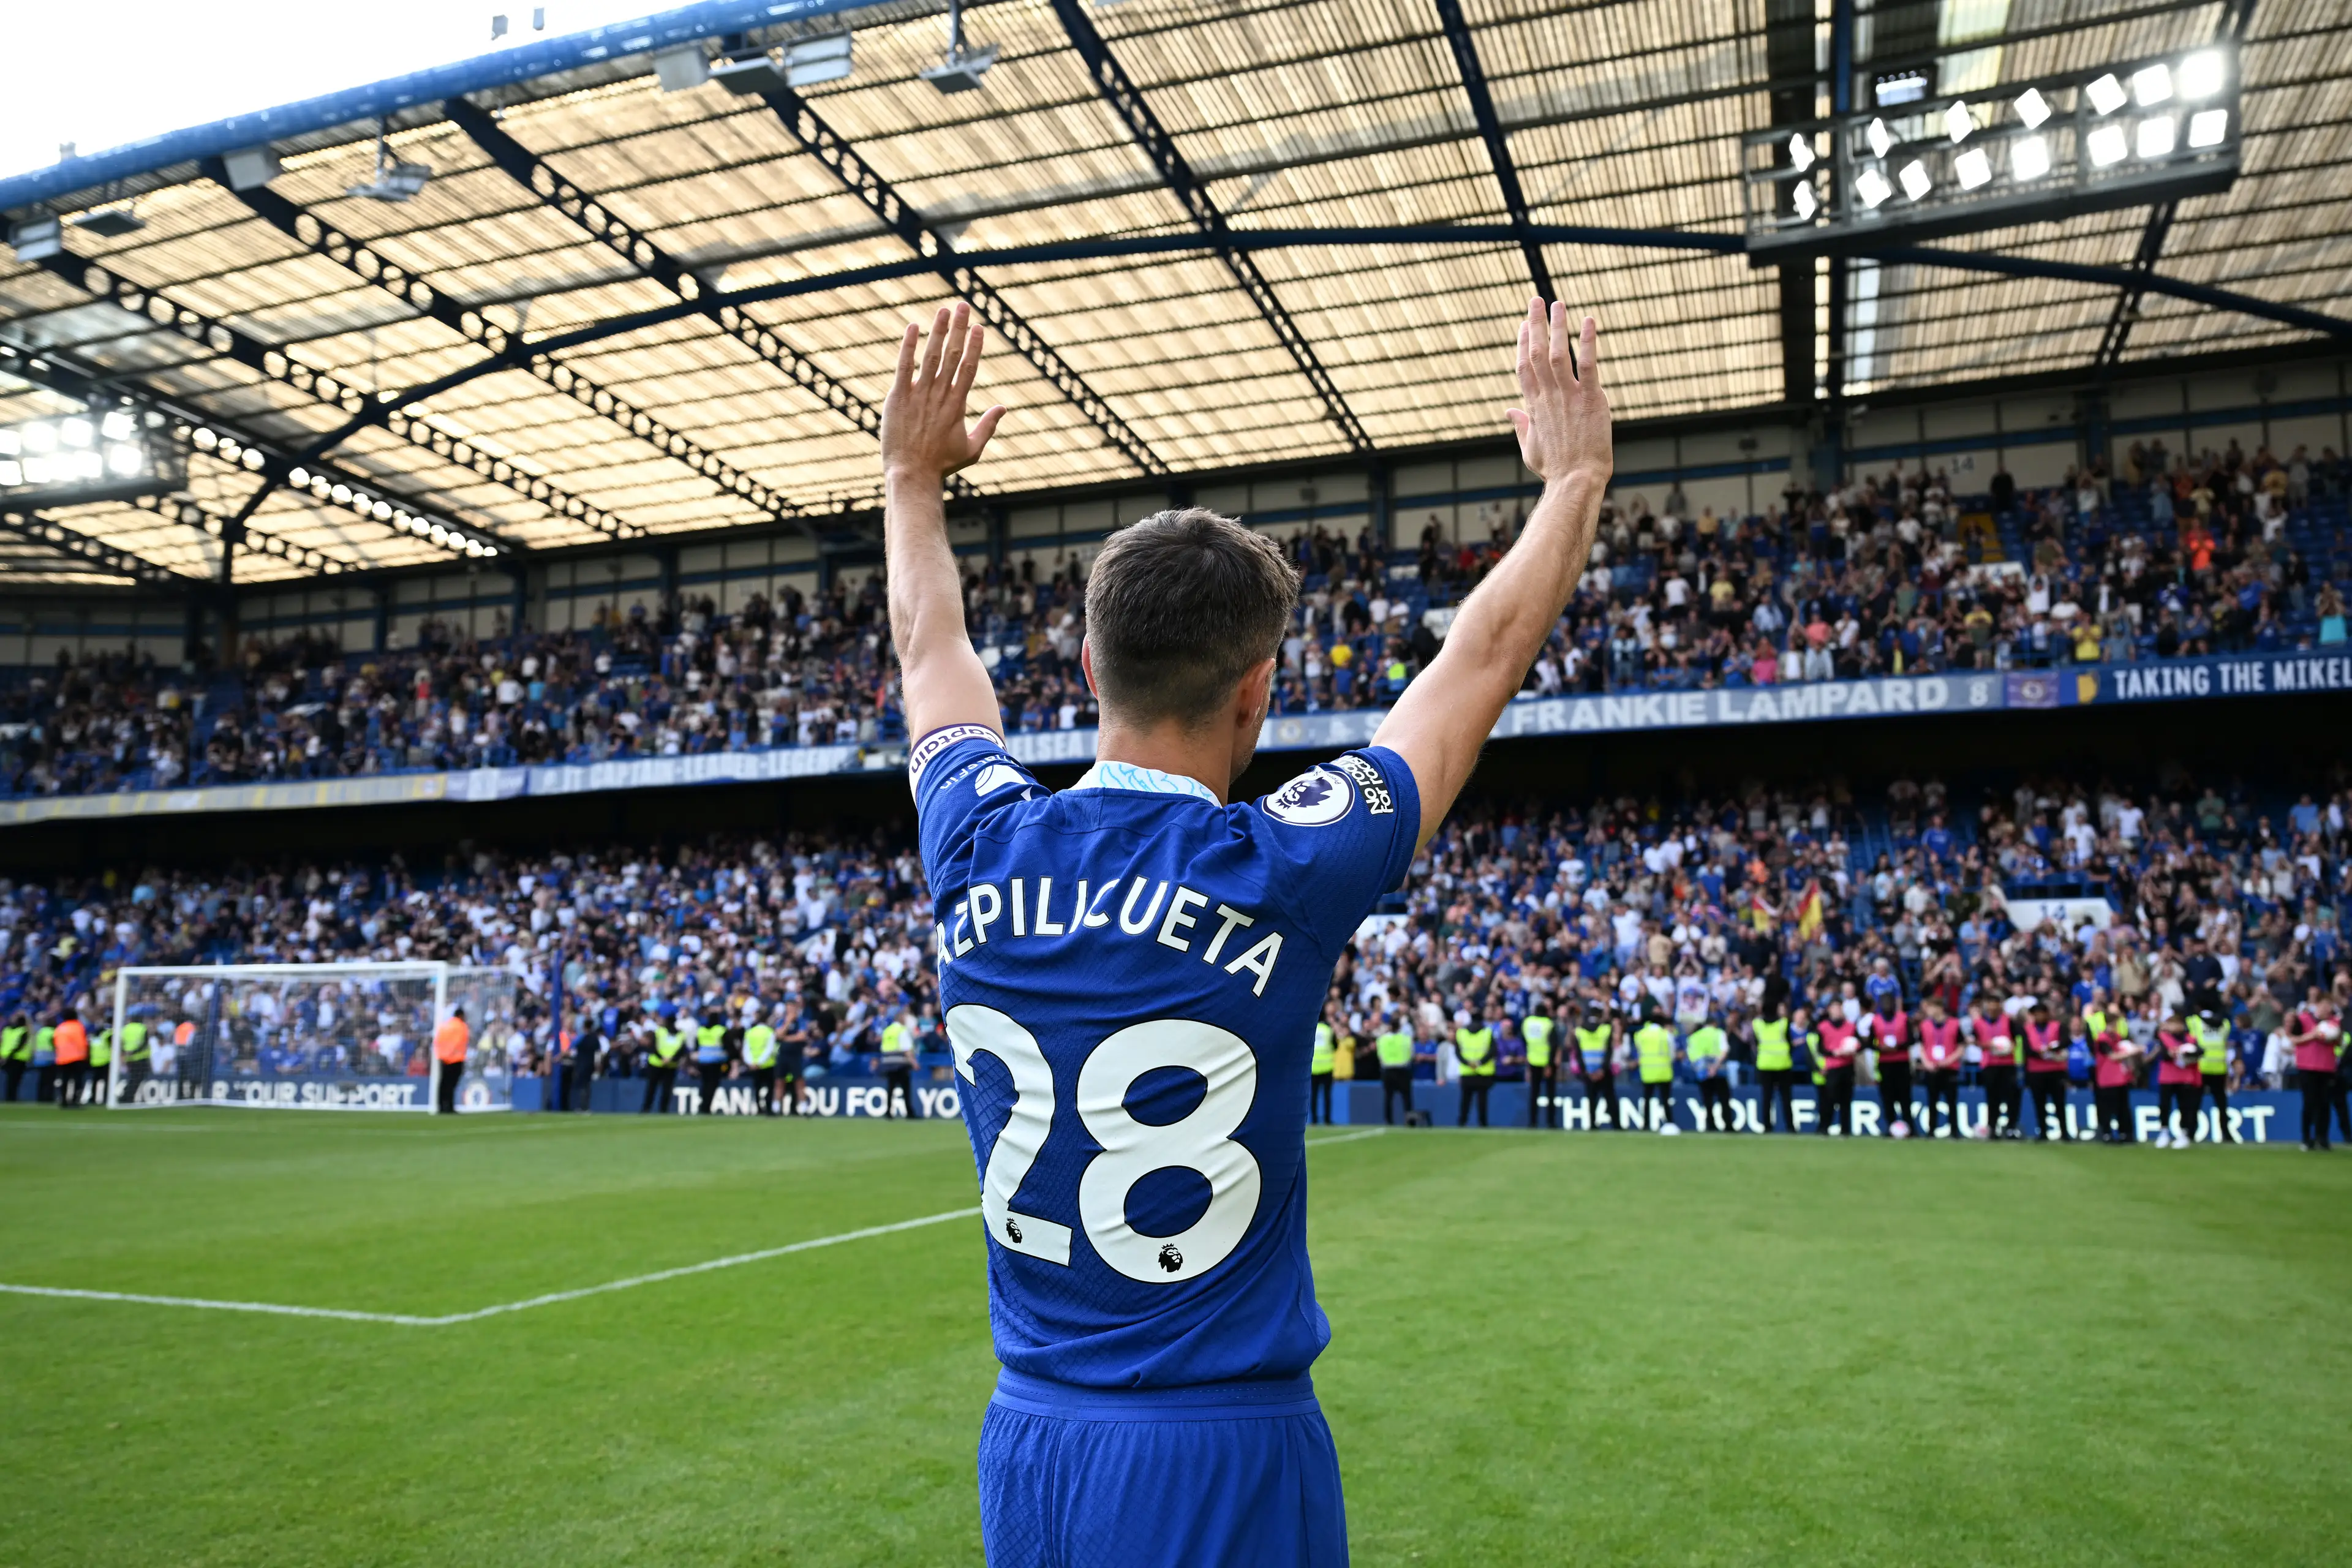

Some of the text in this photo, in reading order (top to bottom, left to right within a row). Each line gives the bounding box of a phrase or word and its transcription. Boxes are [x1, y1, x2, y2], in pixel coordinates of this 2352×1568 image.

[2113, 656, 2352, 699] TAKING THE MIKEL
[1511, 677, 1989, 735] FRANKIE LAMPARD 8
[911, 727, 998, 774] Captain
[1007, 731, 1084, 763] ELSEA
[1343, 763, 1383, 815] No roo
[1790, 1098, 1881, 1137] FR
[945, 1002, 1263, 1285] 28
